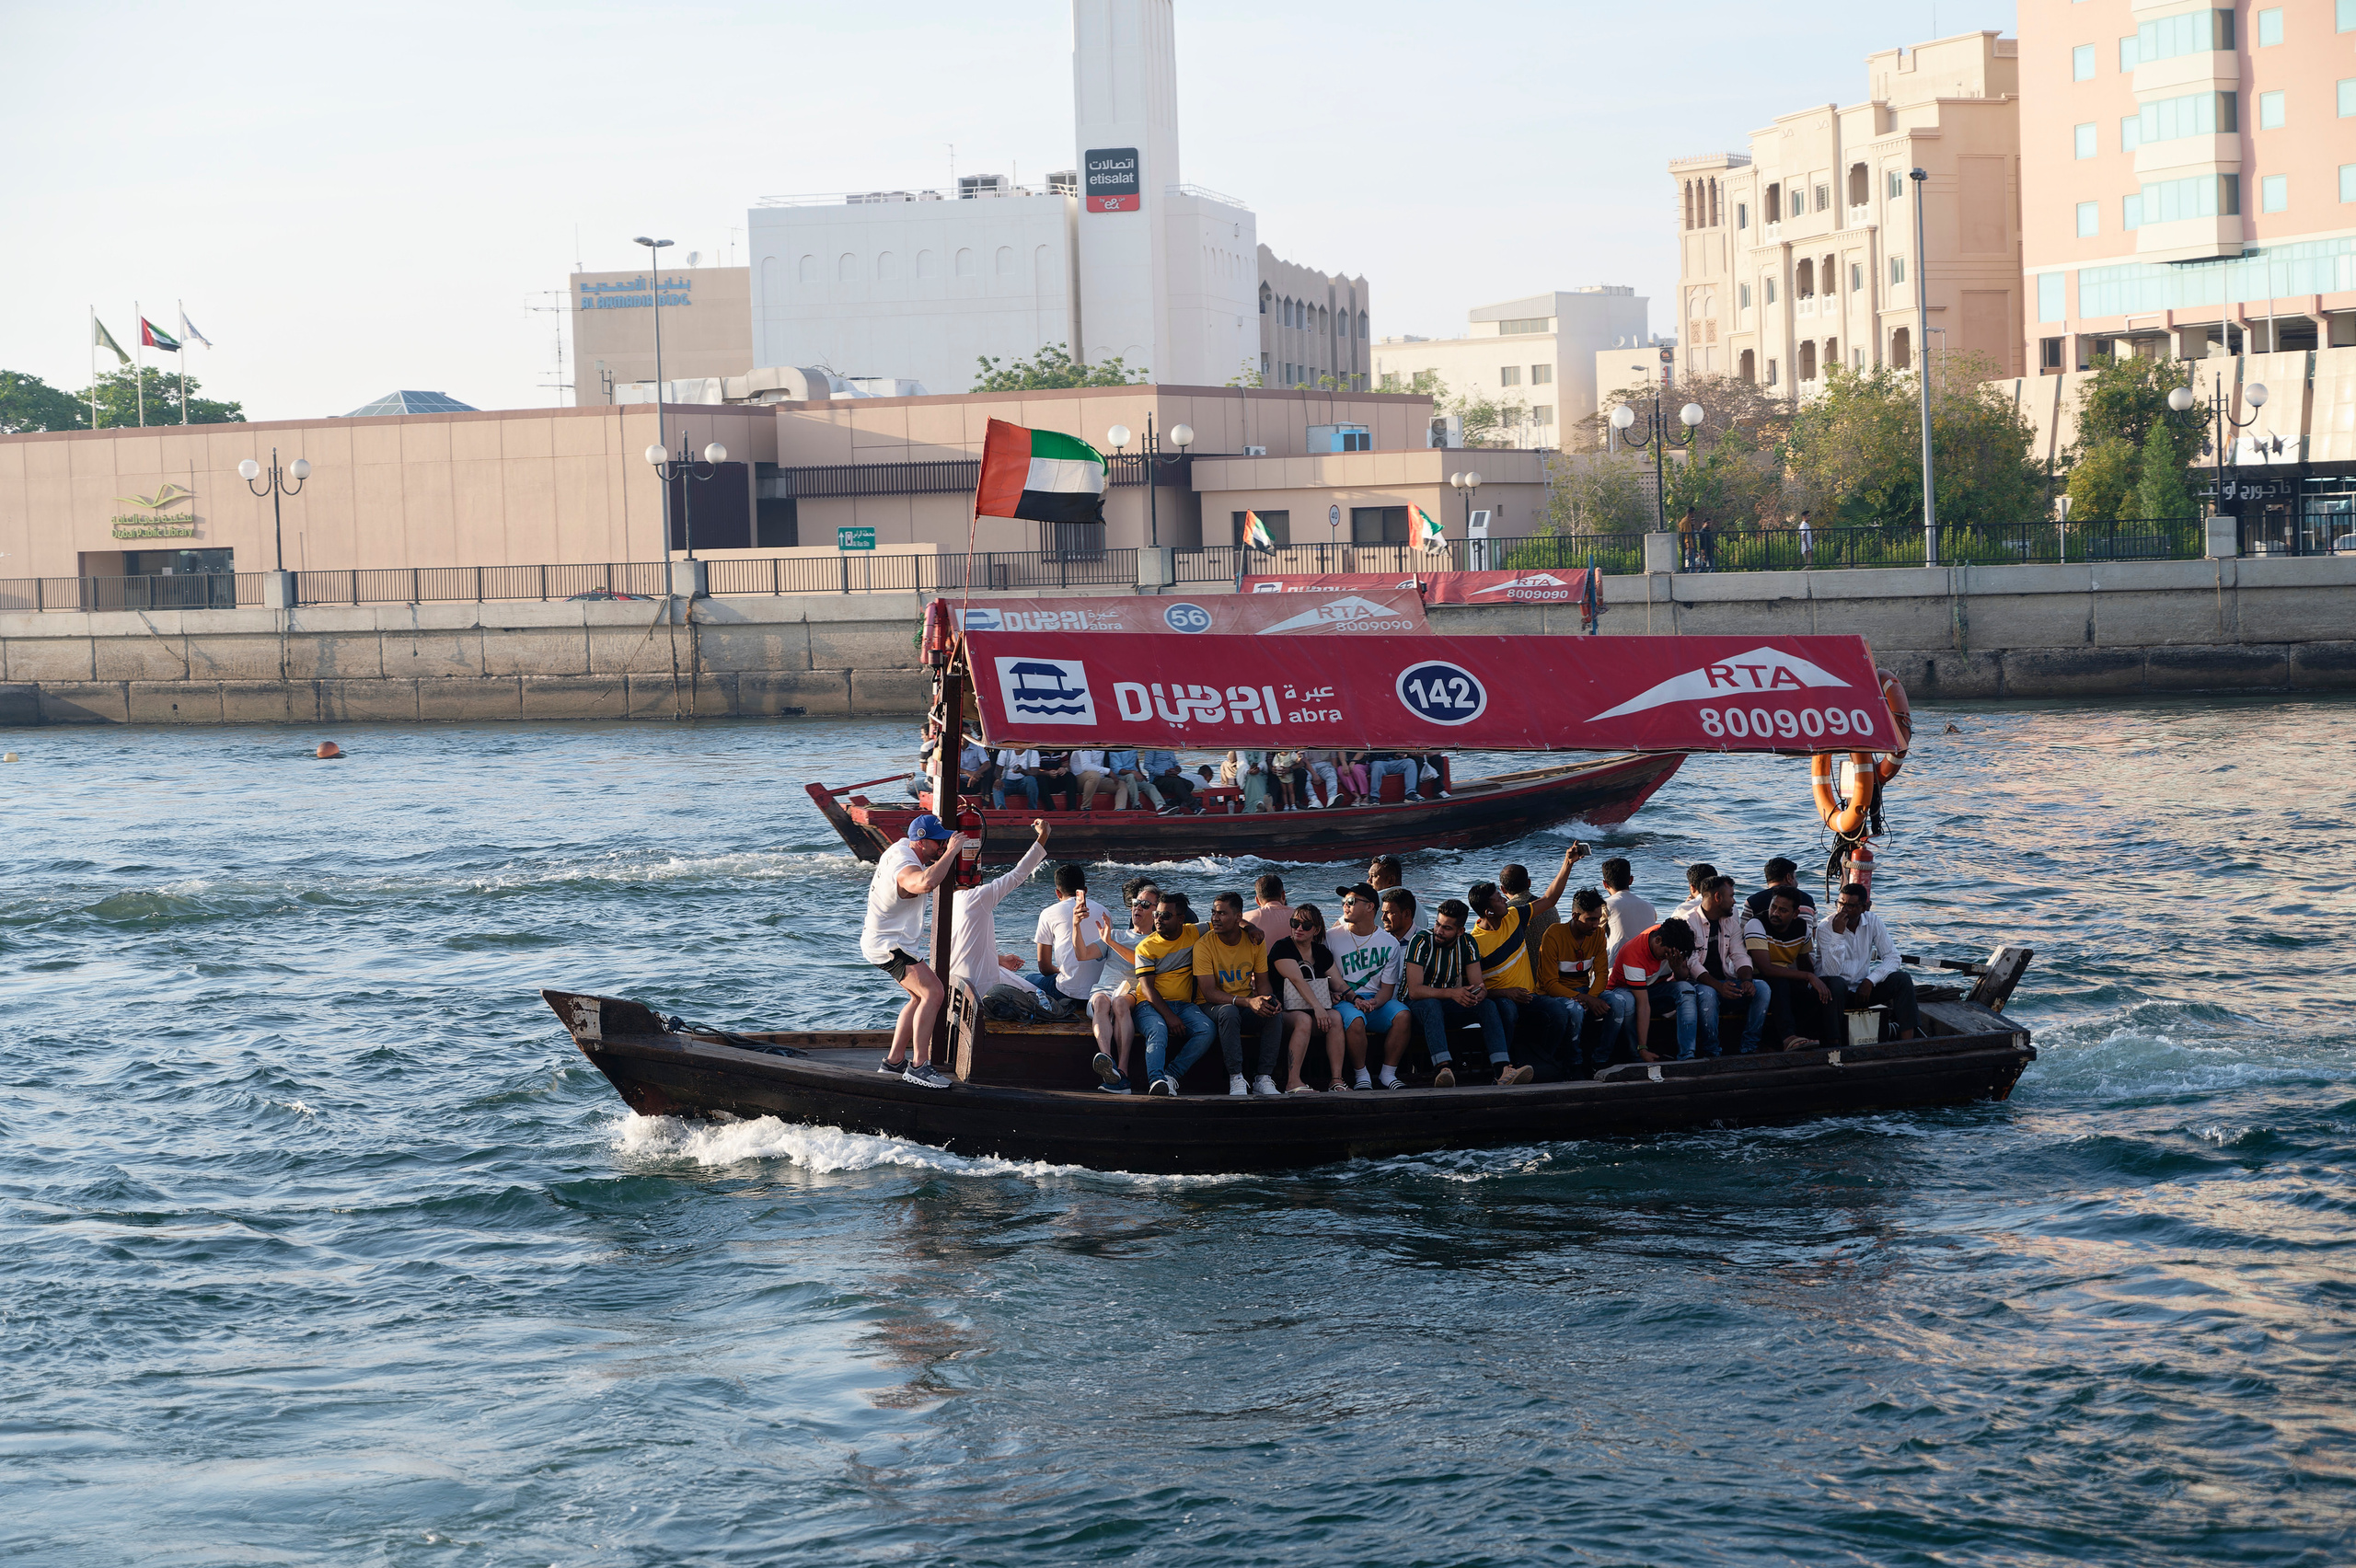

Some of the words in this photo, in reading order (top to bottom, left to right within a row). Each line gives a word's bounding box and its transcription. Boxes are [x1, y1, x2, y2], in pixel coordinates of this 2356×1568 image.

[1089, 158, 1134, 170] اتصالات
[1090, 172, 1134, 185] etisalat
[581, 296, 595, 309] AL
[596, 294, 654, 309] AHMADIA
[139, 514, 161, 525] دبي
[111, 527, 135, 538] Dubai
[136, 527, 162, 537] Public
[164, 526, 193, 537] Library
[1516, 578, 1552, 586] RTA
[1507, 589, 1568, 599] 8009090
[1087, 609, 1119, 620] عبرة
[1316, 605, 1374, 618] RTA
[1003, 611, 1088, 631] DUBAI
[1172, 610, 1205, 628] 56
[1335, 620, 1413, 631] 8009090
[1089, 622, 1123, 631] abra
[1703, 664, 1808, 688] RTA
[1283, 684, 1334, 702] عبرة
[1409, 677, 1475, 709] 142
[1113, 682, 1282, 728] DUBAI
[1288, 708, 1343, 723] abra
[1700, 708, 1875, 738] 8009090
[1341, 946, 1392, 975] FREAK
